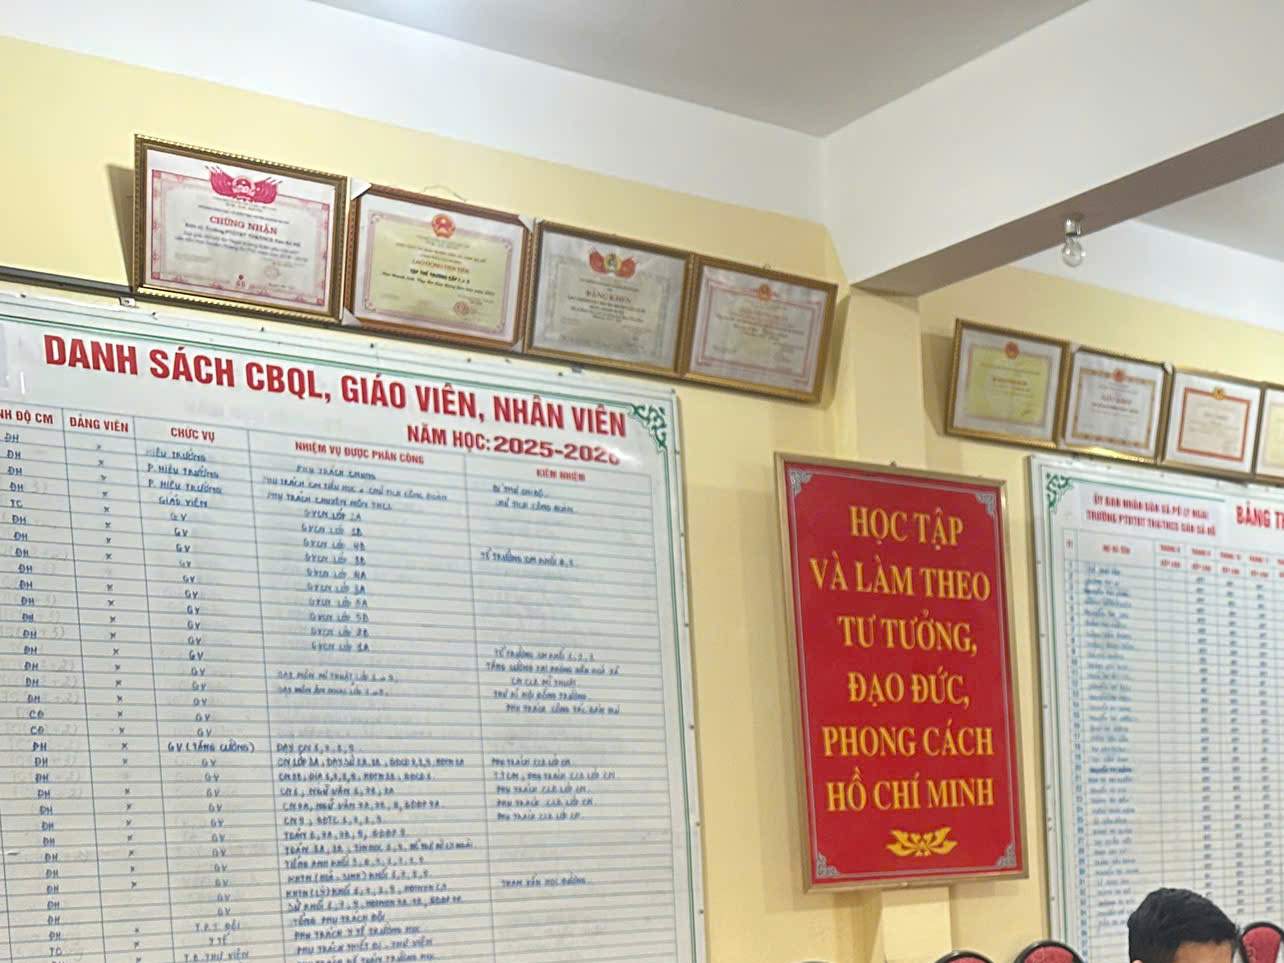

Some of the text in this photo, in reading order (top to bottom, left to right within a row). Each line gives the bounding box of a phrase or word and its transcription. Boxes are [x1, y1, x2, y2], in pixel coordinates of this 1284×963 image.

[44, 334, 627, 437] DANH SÁCH CBQL, GIÁO VIÊN, NHÂN VIÊN
[16, 410, 31, 424] ĐỘ
[35, 413, 53, 424] CM
[69, 414, 129, 433] ĐẢNG VIÊN
[170, 426, 215, 443] CHỨC VỤ
[407, 422, 447, 446] NĂM
[295, 441, 424, 464] NHIỆM VỤ ĐƯỢC PHÂN CÔNG
[849, 505, 964, 551] HỌC TẬP
[1236, 501, 1271, 528] BẢNG
[809, 551, 991, 602] VÀ LÀM THEO
[838, 609, 978, 657] TƯ TƯỞNG,
[848, 665, 970, 711] ĐẠO ĐỨC,
[822, 719, 994, 758] PHONG CÁCH
[826, 767, 994, 812] HỒ CHÍ MINH
